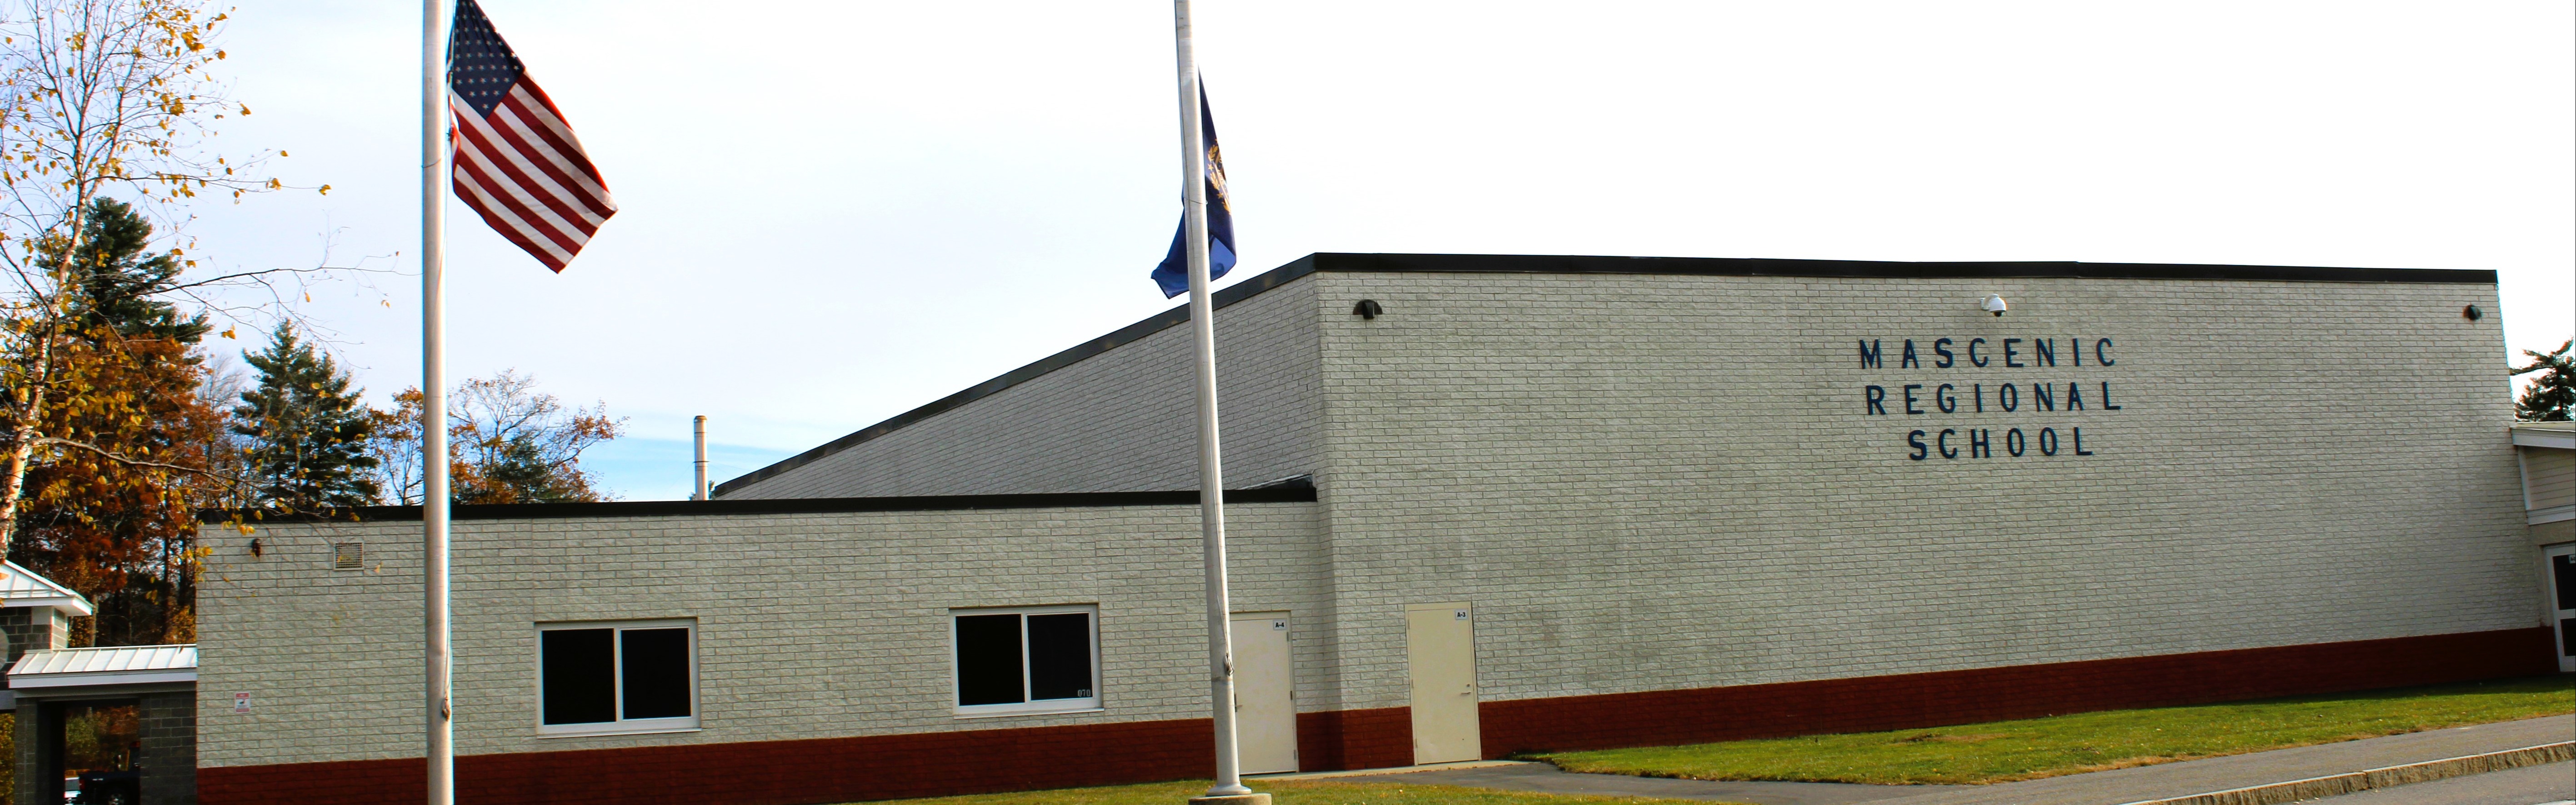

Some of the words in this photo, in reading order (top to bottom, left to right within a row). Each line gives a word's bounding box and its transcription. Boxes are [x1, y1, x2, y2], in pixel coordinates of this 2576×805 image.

[1860, 338, 2115, 369] MASCENIC
[1866, 382, 2121, 415] REGIONAL
[1909, 427, 2093, 461] SCHOOL
